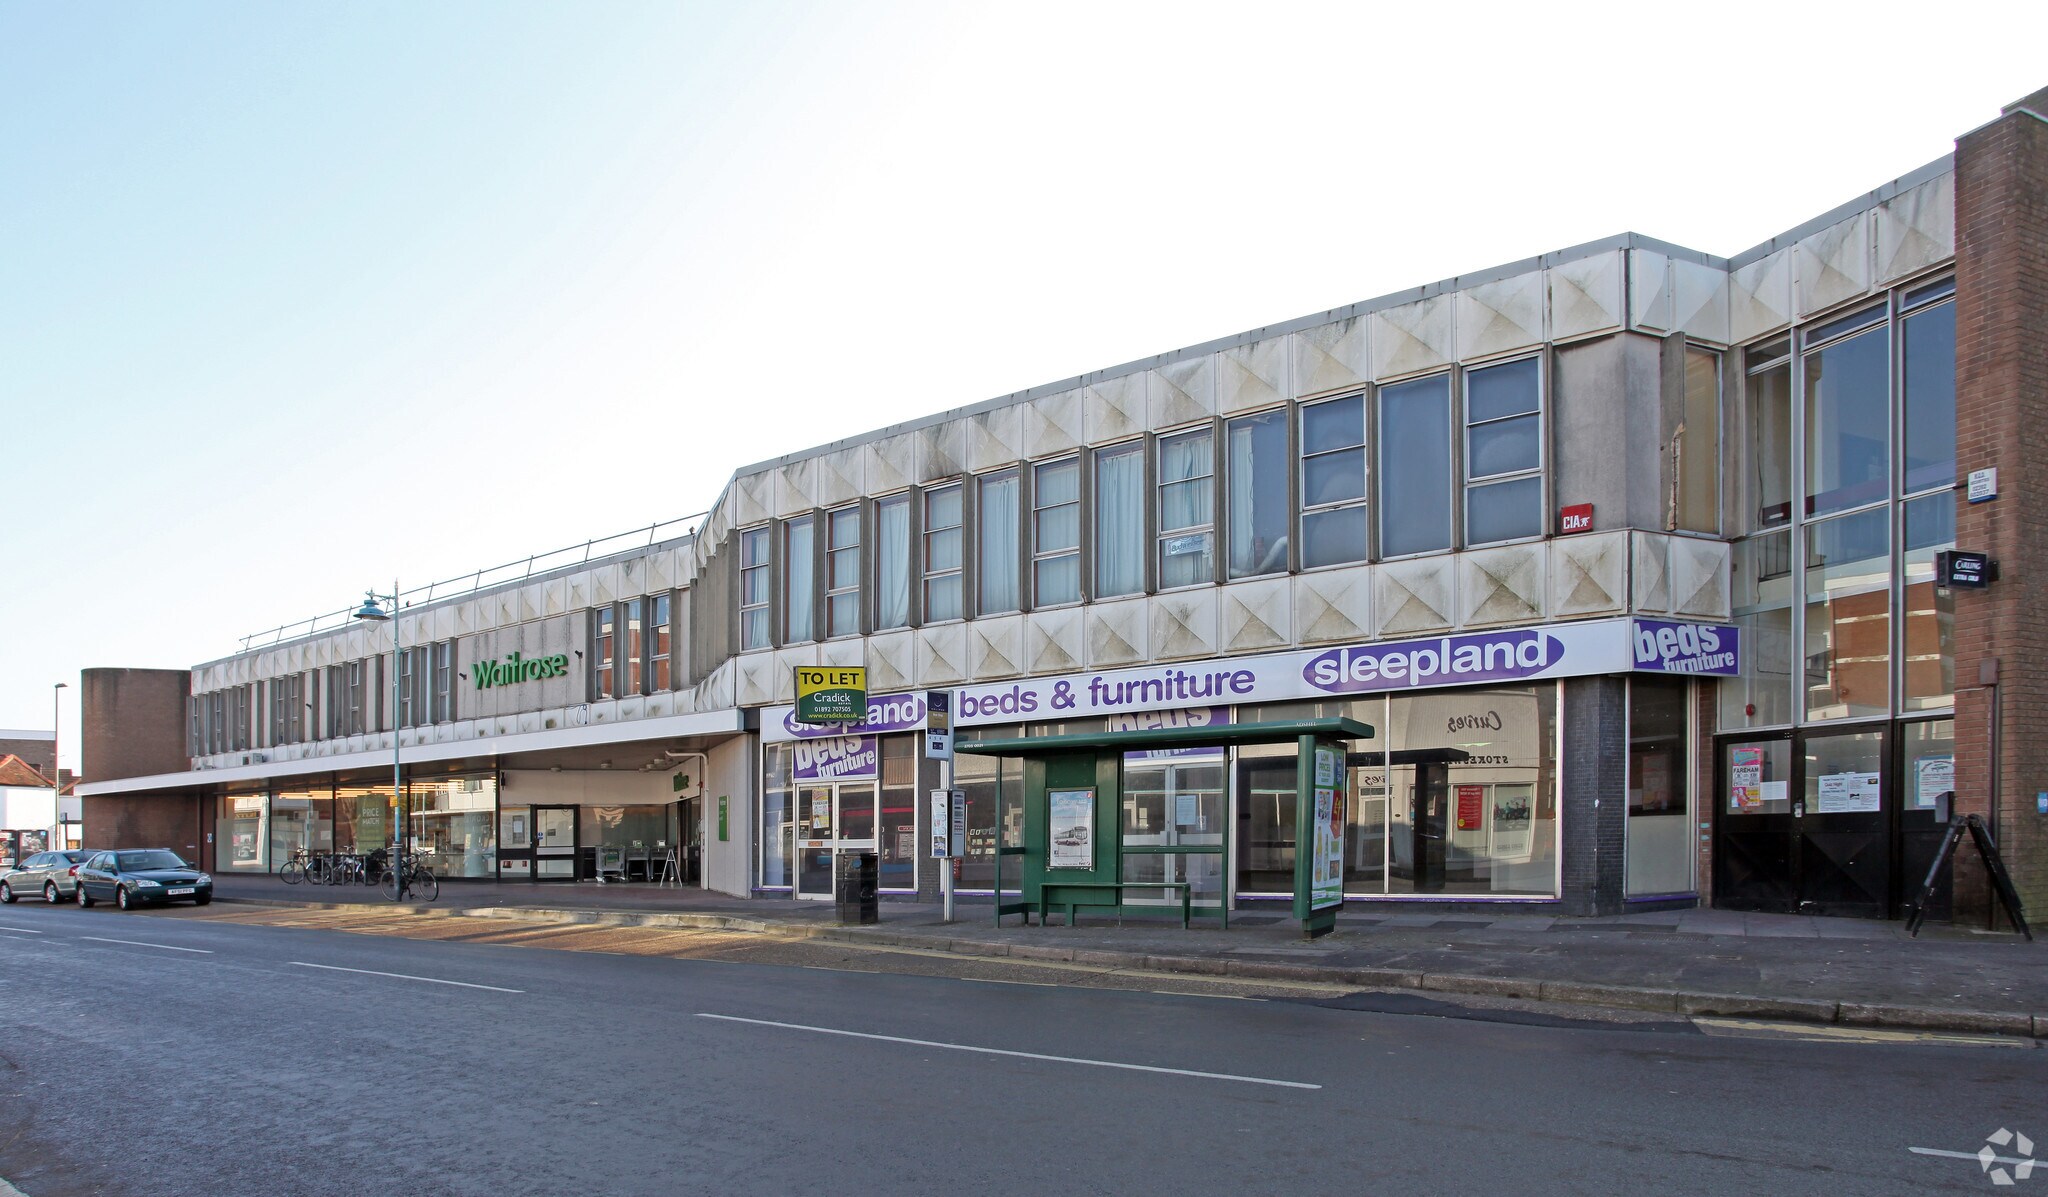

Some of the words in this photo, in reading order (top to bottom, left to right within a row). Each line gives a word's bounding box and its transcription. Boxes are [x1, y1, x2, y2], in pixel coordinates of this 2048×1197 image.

[1563, 515, 1580, 529] CIA
[1634, 623, 1720, 663] beds
[471, 651, 568, 690] Waitrose
[1314, 631, 1547, 686] sleepland
[1663, 652, 1735, 673] furniture
[800, 672, 824, 685] TO
[829, 672, 859, 685] LET
[813, 692, 851, 703] Cradick
[959, 685, 1038, 718] beds
[1050, 680, 1076, 710] &
[1088, 668, 1256, 706] furniture
[817, 750, 875, 778] furniture
[362, 807, 380, 817] PRICE
